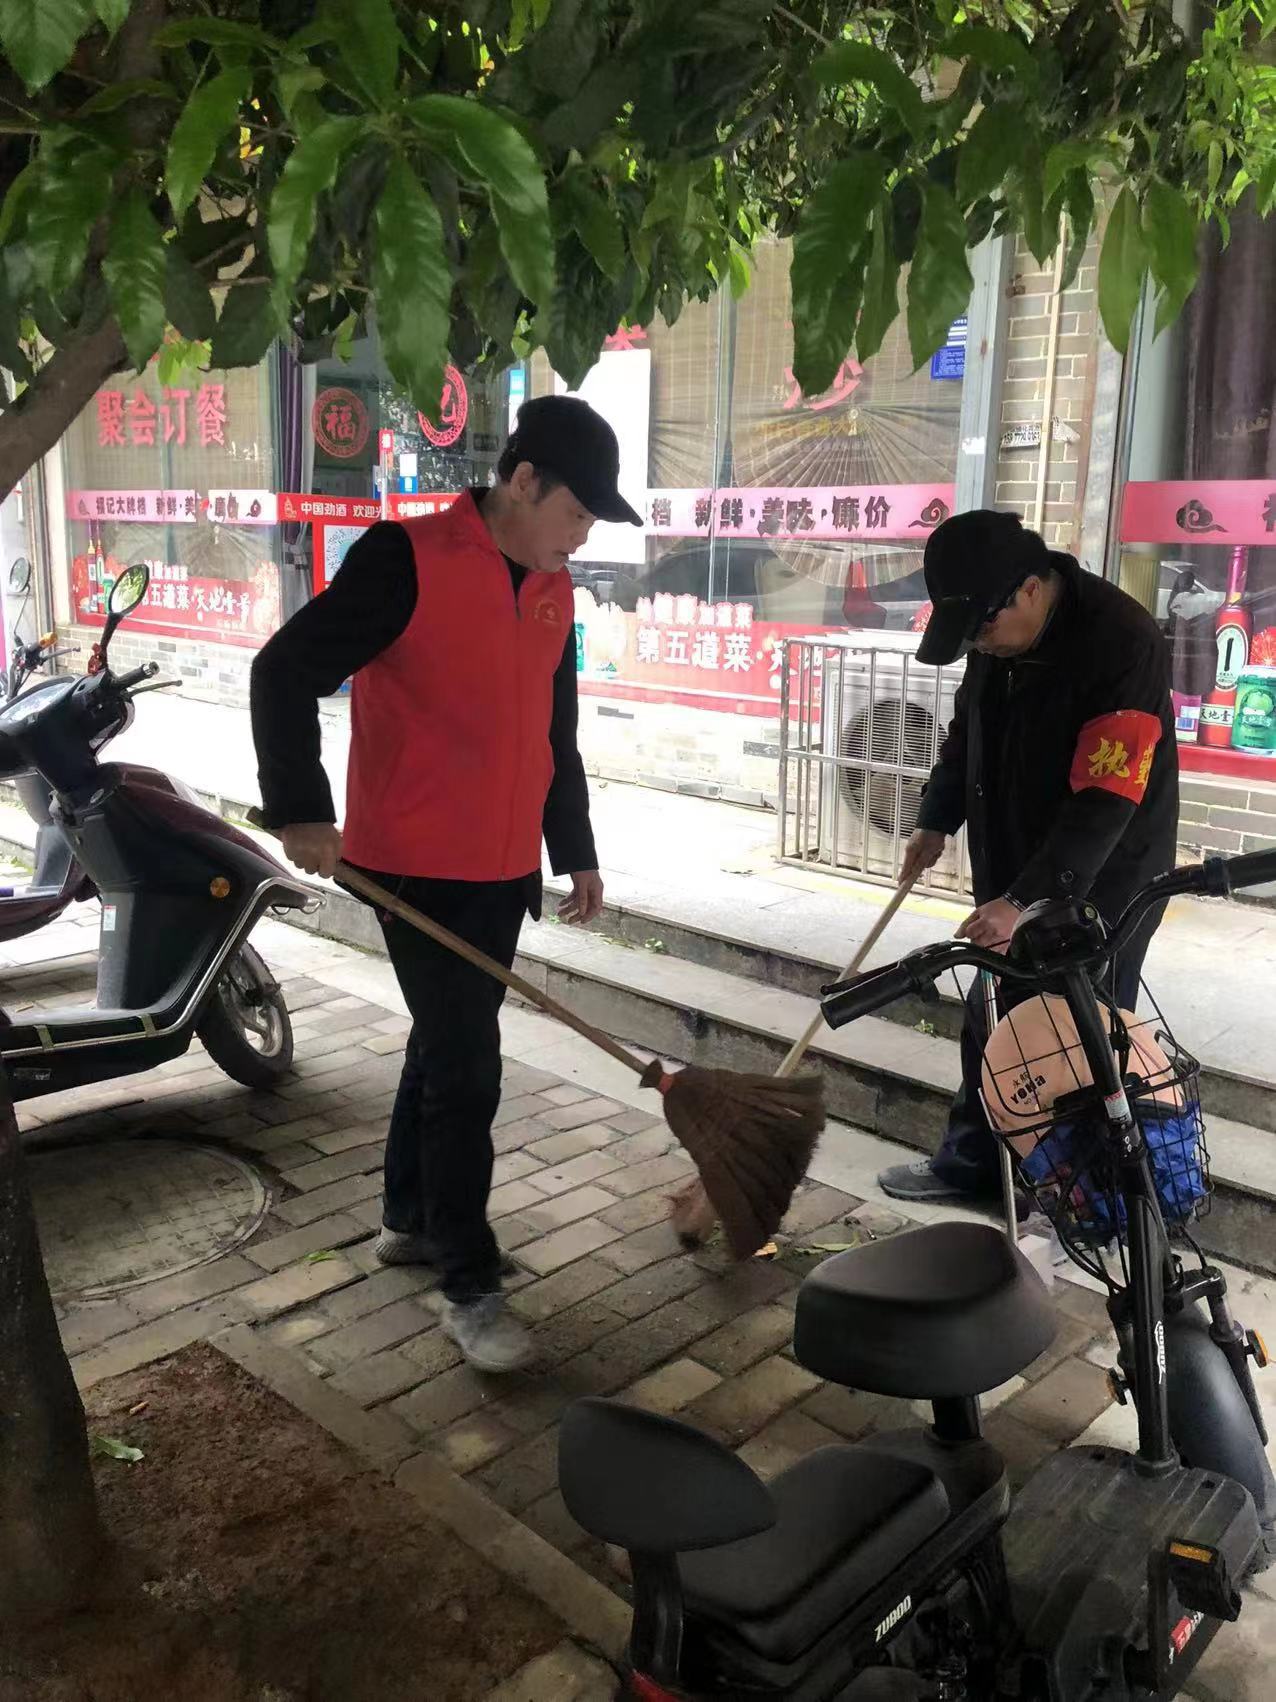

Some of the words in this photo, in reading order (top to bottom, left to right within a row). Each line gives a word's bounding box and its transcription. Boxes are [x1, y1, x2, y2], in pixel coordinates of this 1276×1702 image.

[96, 384, 226, 446] 聚会订餐
[301, 502, 347, 517] 中国劲酒
